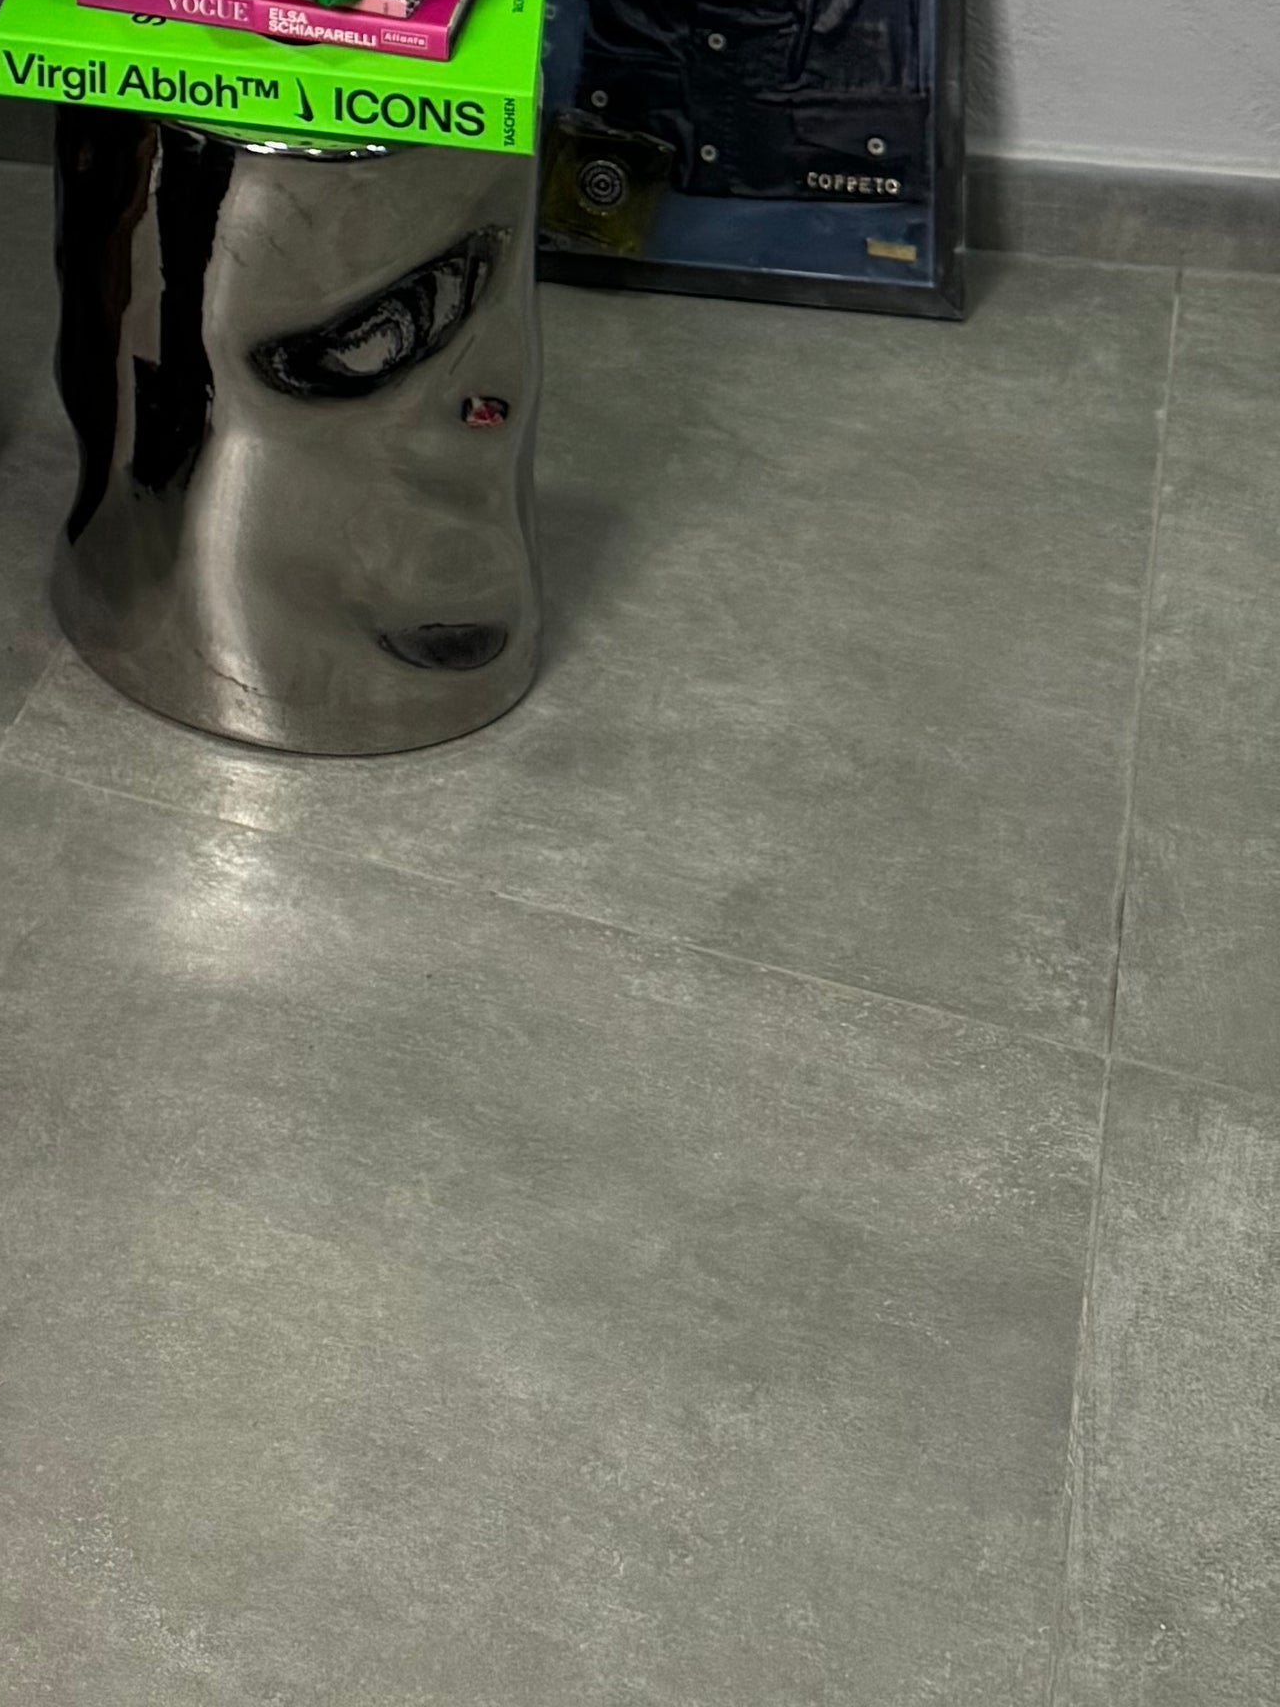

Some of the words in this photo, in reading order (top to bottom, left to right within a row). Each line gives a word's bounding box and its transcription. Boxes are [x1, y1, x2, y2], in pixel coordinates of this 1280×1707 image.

[268, 7, 308, 25] ELSA
[268, 19, 377, 47] SCHIAPARELLI
[3, 49, 107, 101] Virgil
[334, 87, 486, 137] ICONS
[503, 98, 516, 148] TASCHEN
[807, 171, 902, 196] COPPETO
